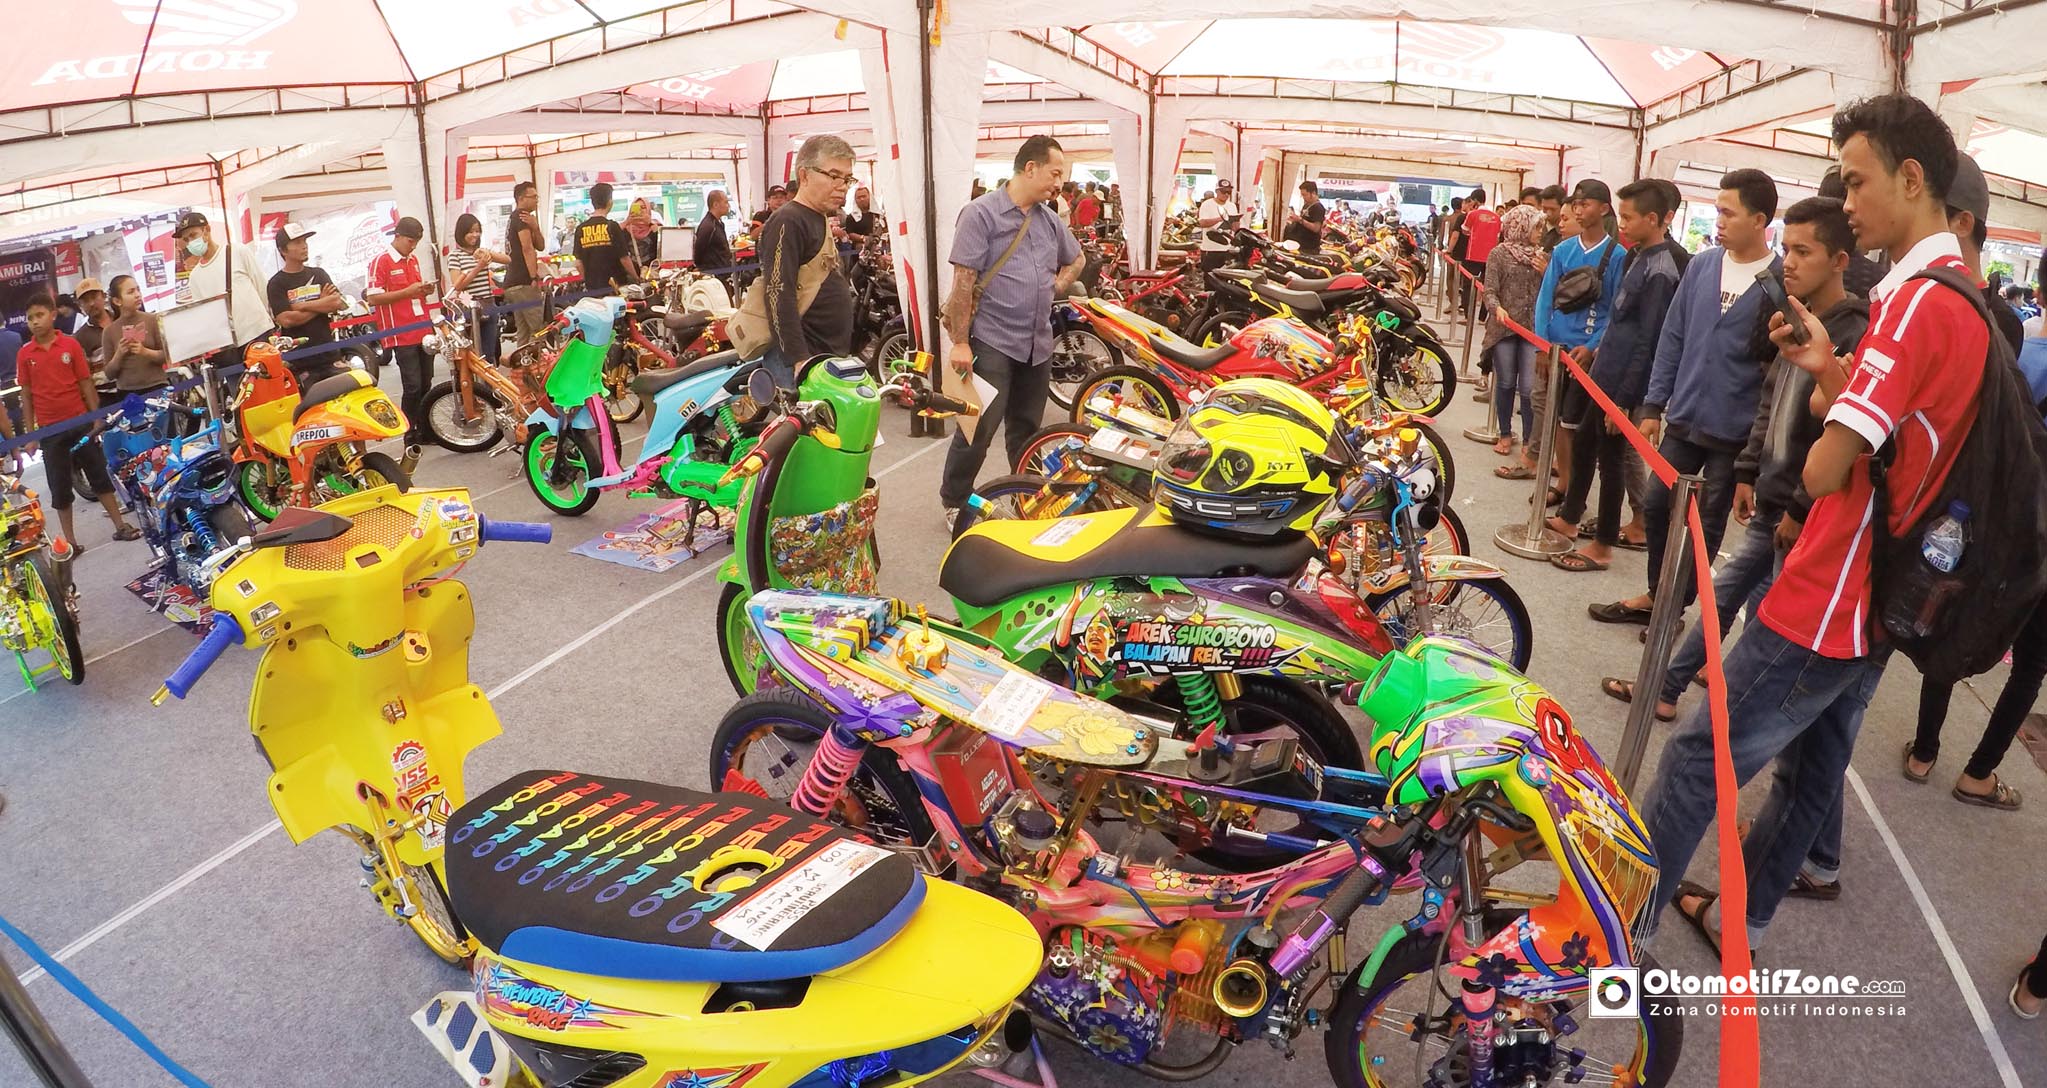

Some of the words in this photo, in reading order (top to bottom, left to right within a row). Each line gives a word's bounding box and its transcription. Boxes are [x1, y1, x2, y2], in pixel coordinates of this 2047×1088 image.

[681, 400, 697, 418] 070
[300, 429, 331, 440] REPSOL
[1125, 621, 1173, 644] AREK
[1175, 623, 1277, 649] SUROBOYO
[1123, 643, 1191, 663] BALAPAN
[501, 984, 564, 1008] NEWBIE
[527, 1006, 573, 1031] RACE
